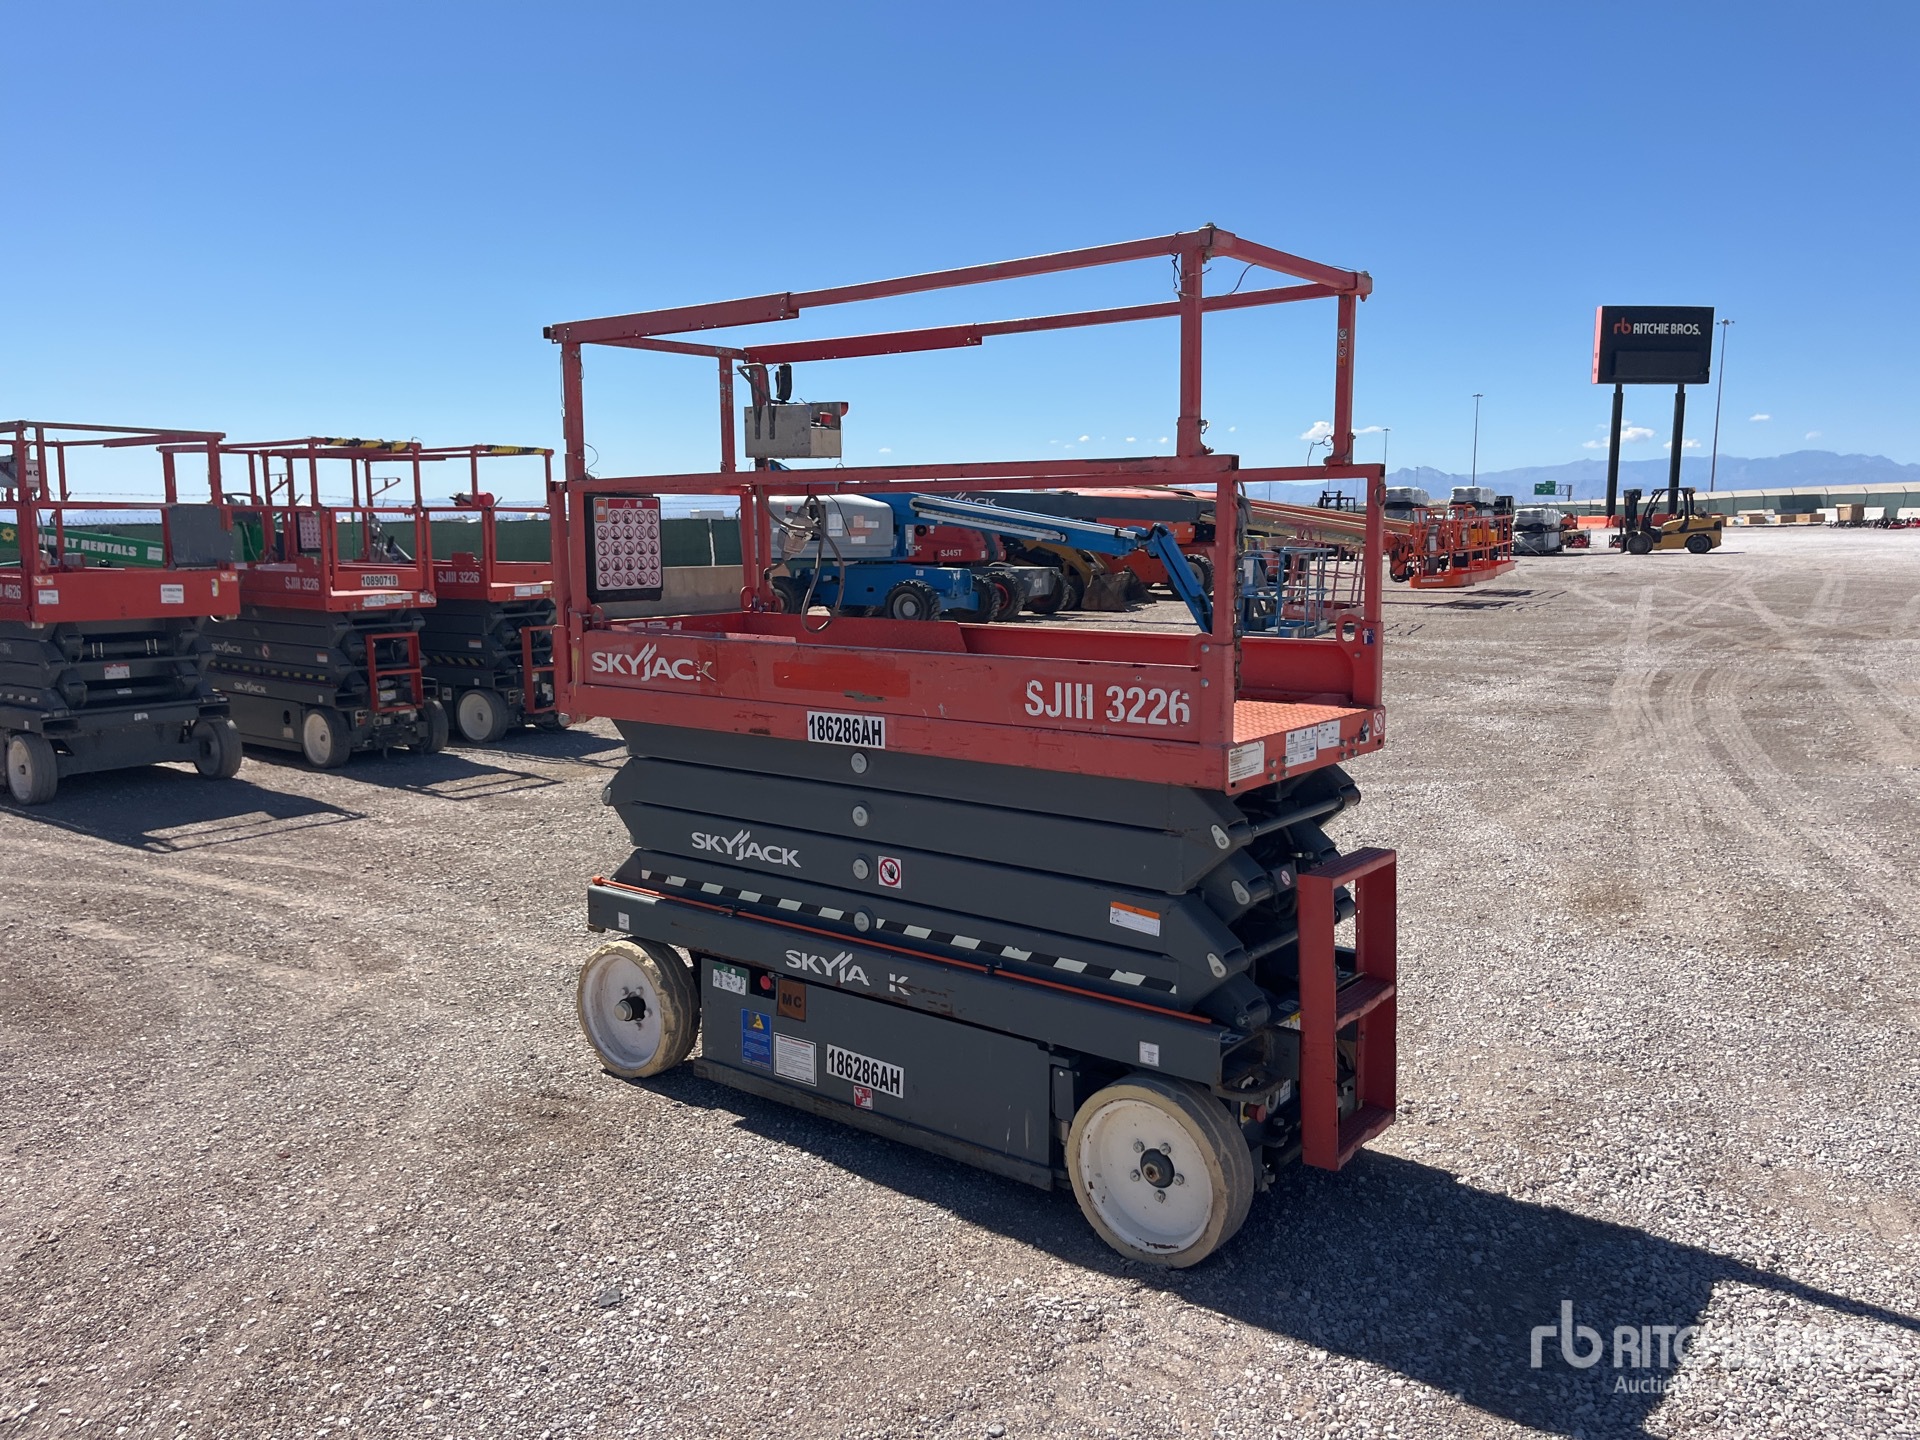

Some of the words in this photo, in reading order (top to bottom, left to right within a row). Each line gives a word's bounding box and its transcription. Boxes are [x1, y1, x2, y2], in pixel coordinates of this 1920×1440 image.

[1632, 322, 1669, 335] RITCHIE
[1670, 323, 1701, 335] BROS.
[80, 539, 138, 556] RENTALS
[301, 577, 320, 591] 3226
[361, 575, 397, 586] 10890718
[458, 571, 480, 583] 3226
[1105, 685, 1191, 727] 3226
[808, 714, 883, 747] 186286AH
[691, 829, 802, 868] SKYJACK
[828, 1048, 901, 1095] 186286AH
